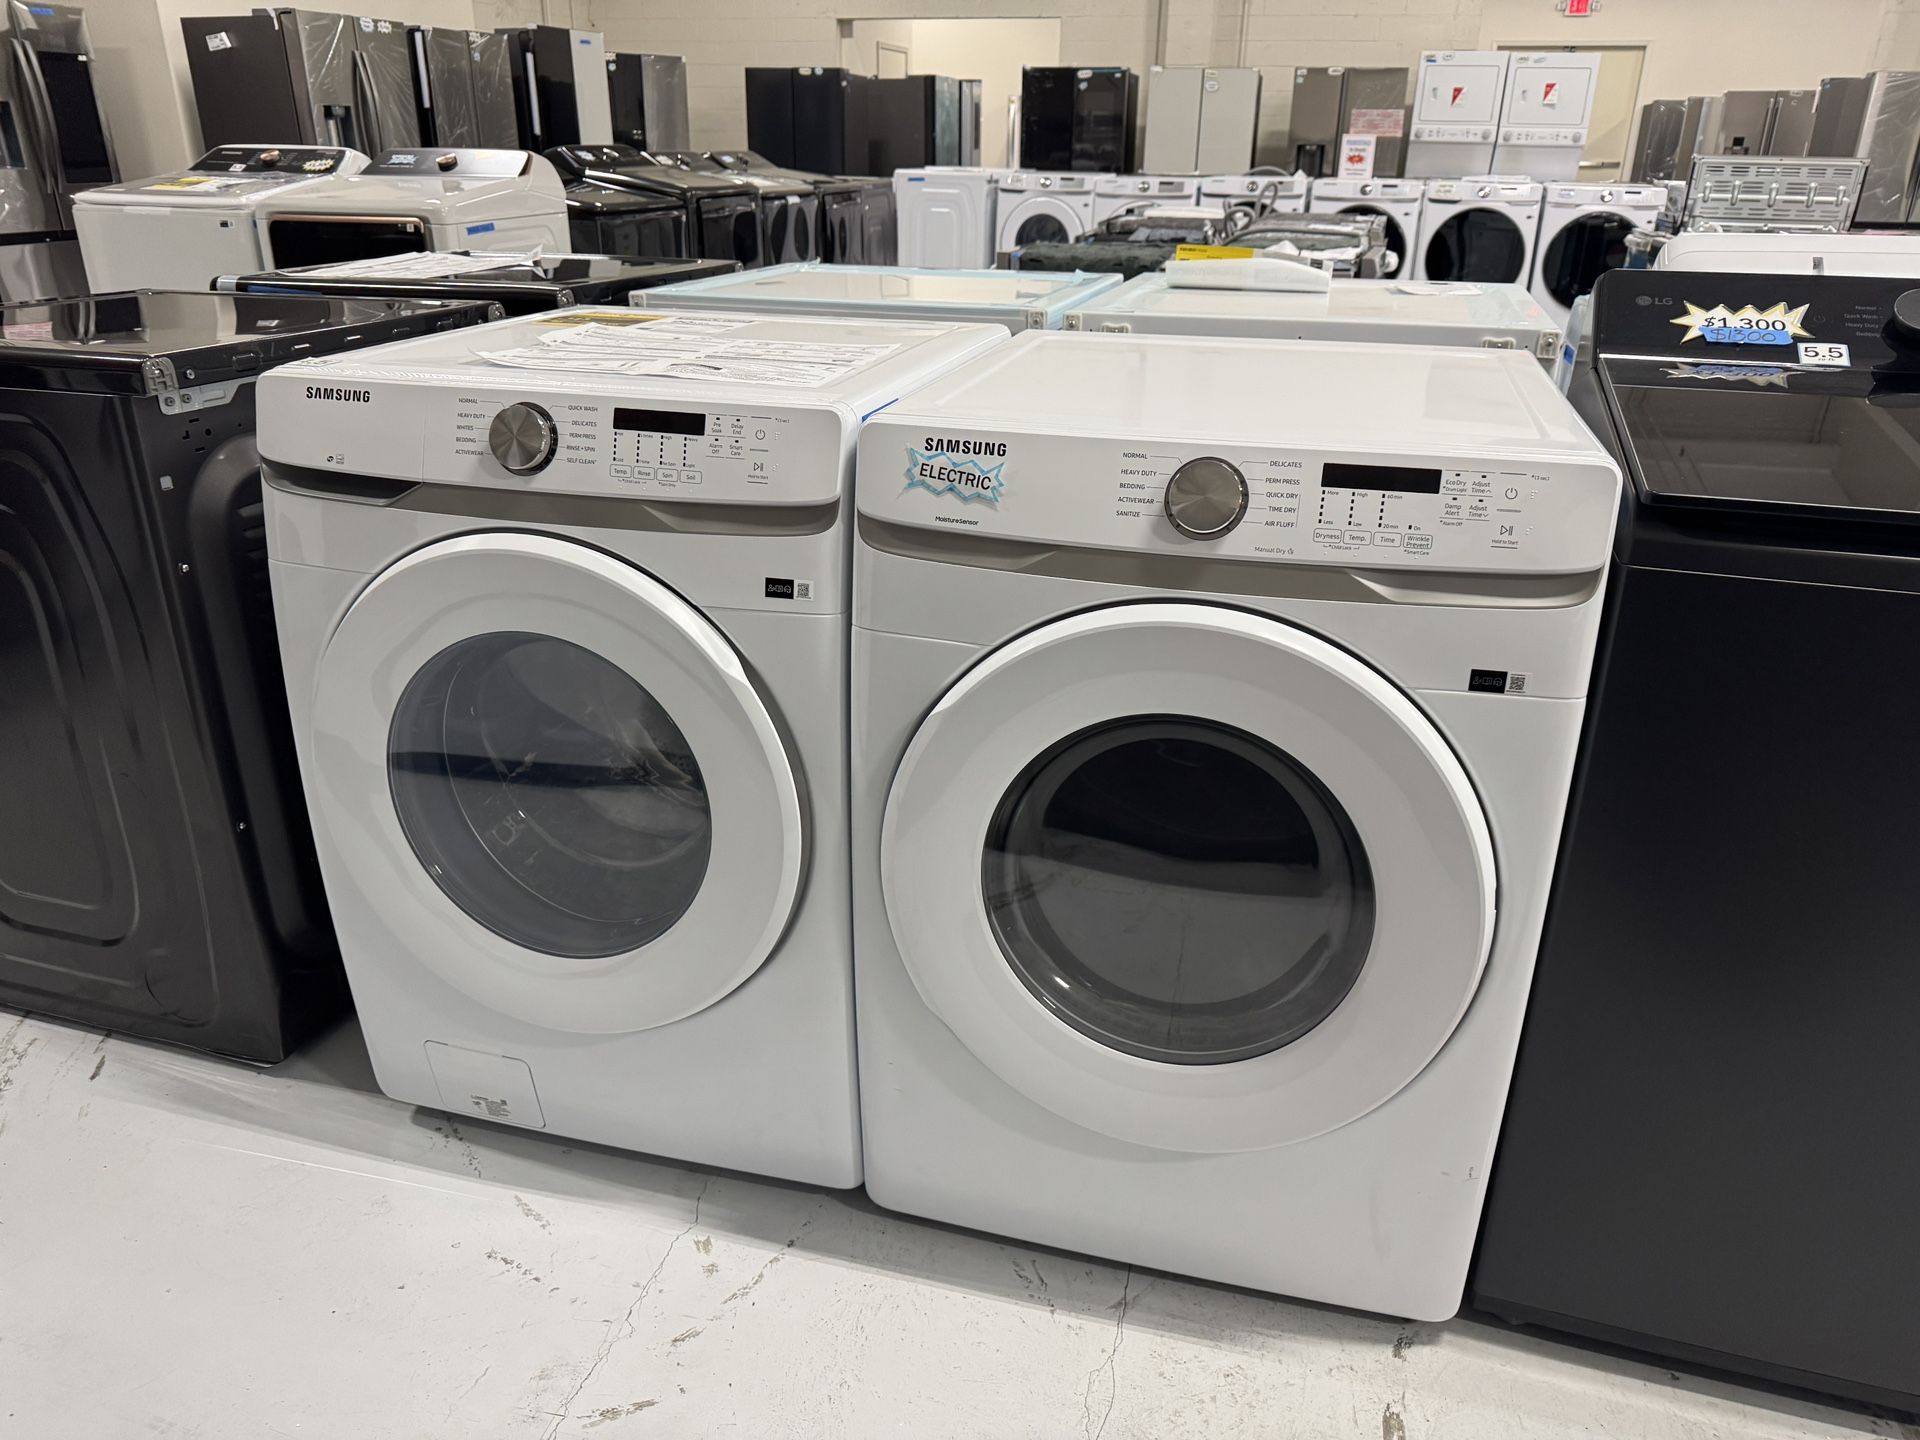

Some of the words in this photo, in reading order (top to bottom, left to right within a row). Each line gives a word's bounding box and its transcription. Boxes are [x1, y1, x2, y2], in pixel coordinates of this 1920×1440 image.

[1711, 329, 1776, 342] $1300
[1804, 347, 1843, 358] 5.5
[306, 387, 370, 402] SAMSUNG
[925, 438, 1006, 456] SAMSUNG
[920, 463, 991, 490] ELECTRIC
